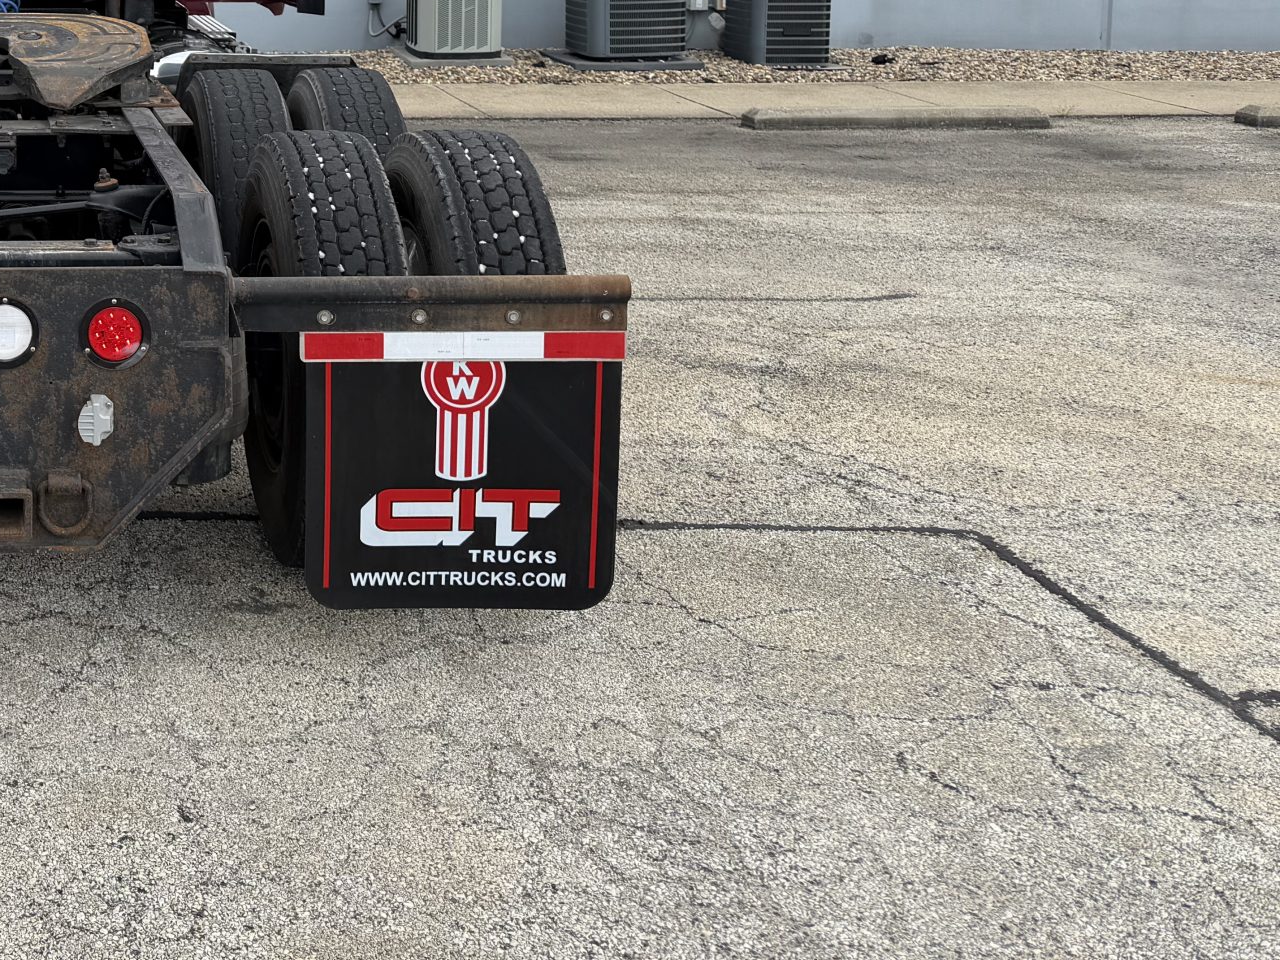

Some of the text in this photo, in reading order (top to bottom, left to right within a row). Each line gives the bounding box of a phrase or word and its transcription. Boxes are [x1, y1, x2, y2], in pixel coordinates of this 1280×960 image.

[445, 376, 480, 401] W
[359, 487, 561, 547] CIT
[468, 549, 557, 564] TRUCKS
[350, 571, 567, 588] WWW.CITTRUCKS.COM
